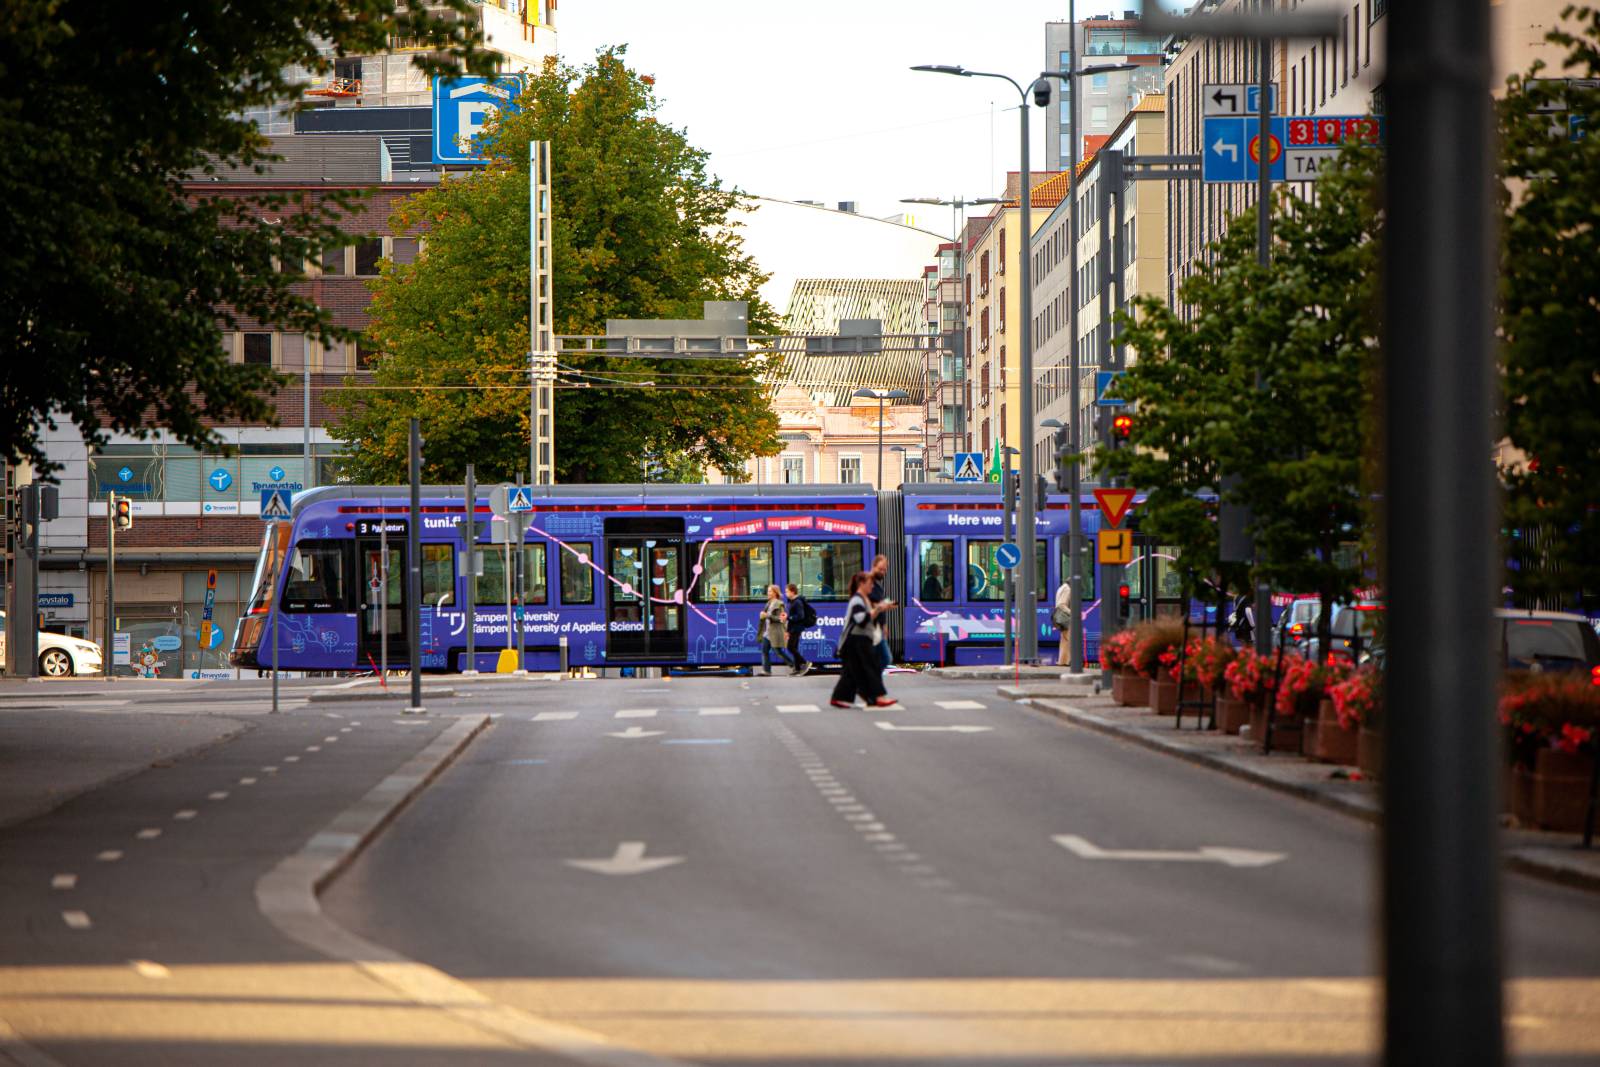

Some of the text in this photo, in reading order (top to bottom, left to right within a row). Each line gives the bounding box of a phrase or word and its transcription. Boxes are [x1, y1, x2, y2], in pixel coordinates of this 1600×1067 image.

[1296, 122, 1373, 142] 3 9 12
[252, 482, 303, 492] Terveystalo
[947, 514, 980, 525] Here
[982, 517, 1002, 525] we
[361, 523, 367, 533] 3
[474, 612, 509, 624] amper
[816, 615, 846, 627] oten
[473, 623, 509, 635] Tamper
[561, 622, 571, 632] of
[572, 622, 606, 634] Applied
[610, 621, 653, 632] Sciencs
